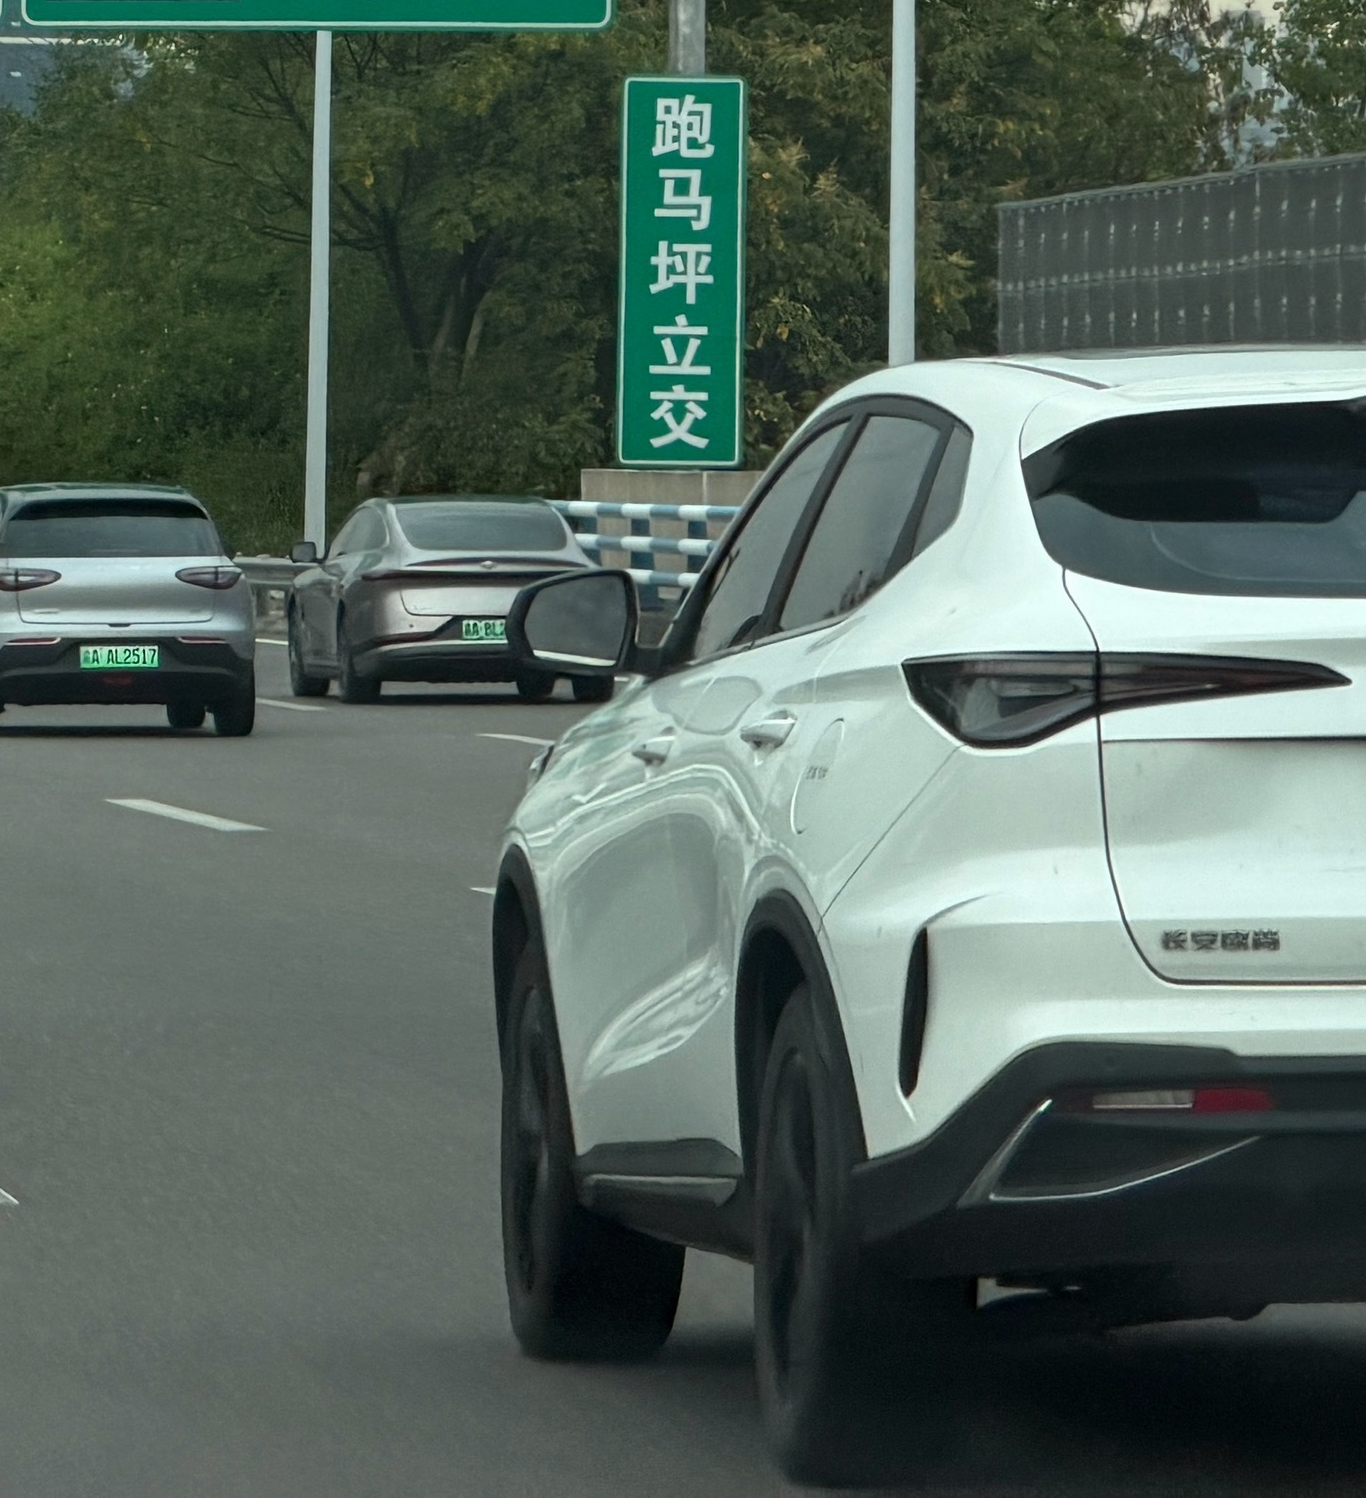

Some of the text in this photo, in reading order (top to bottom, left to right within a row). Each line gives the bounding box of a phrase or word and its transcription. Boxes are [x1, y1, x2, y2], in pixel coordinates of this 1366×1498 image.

[648, 94, 715, 449] 跑马坪立交
